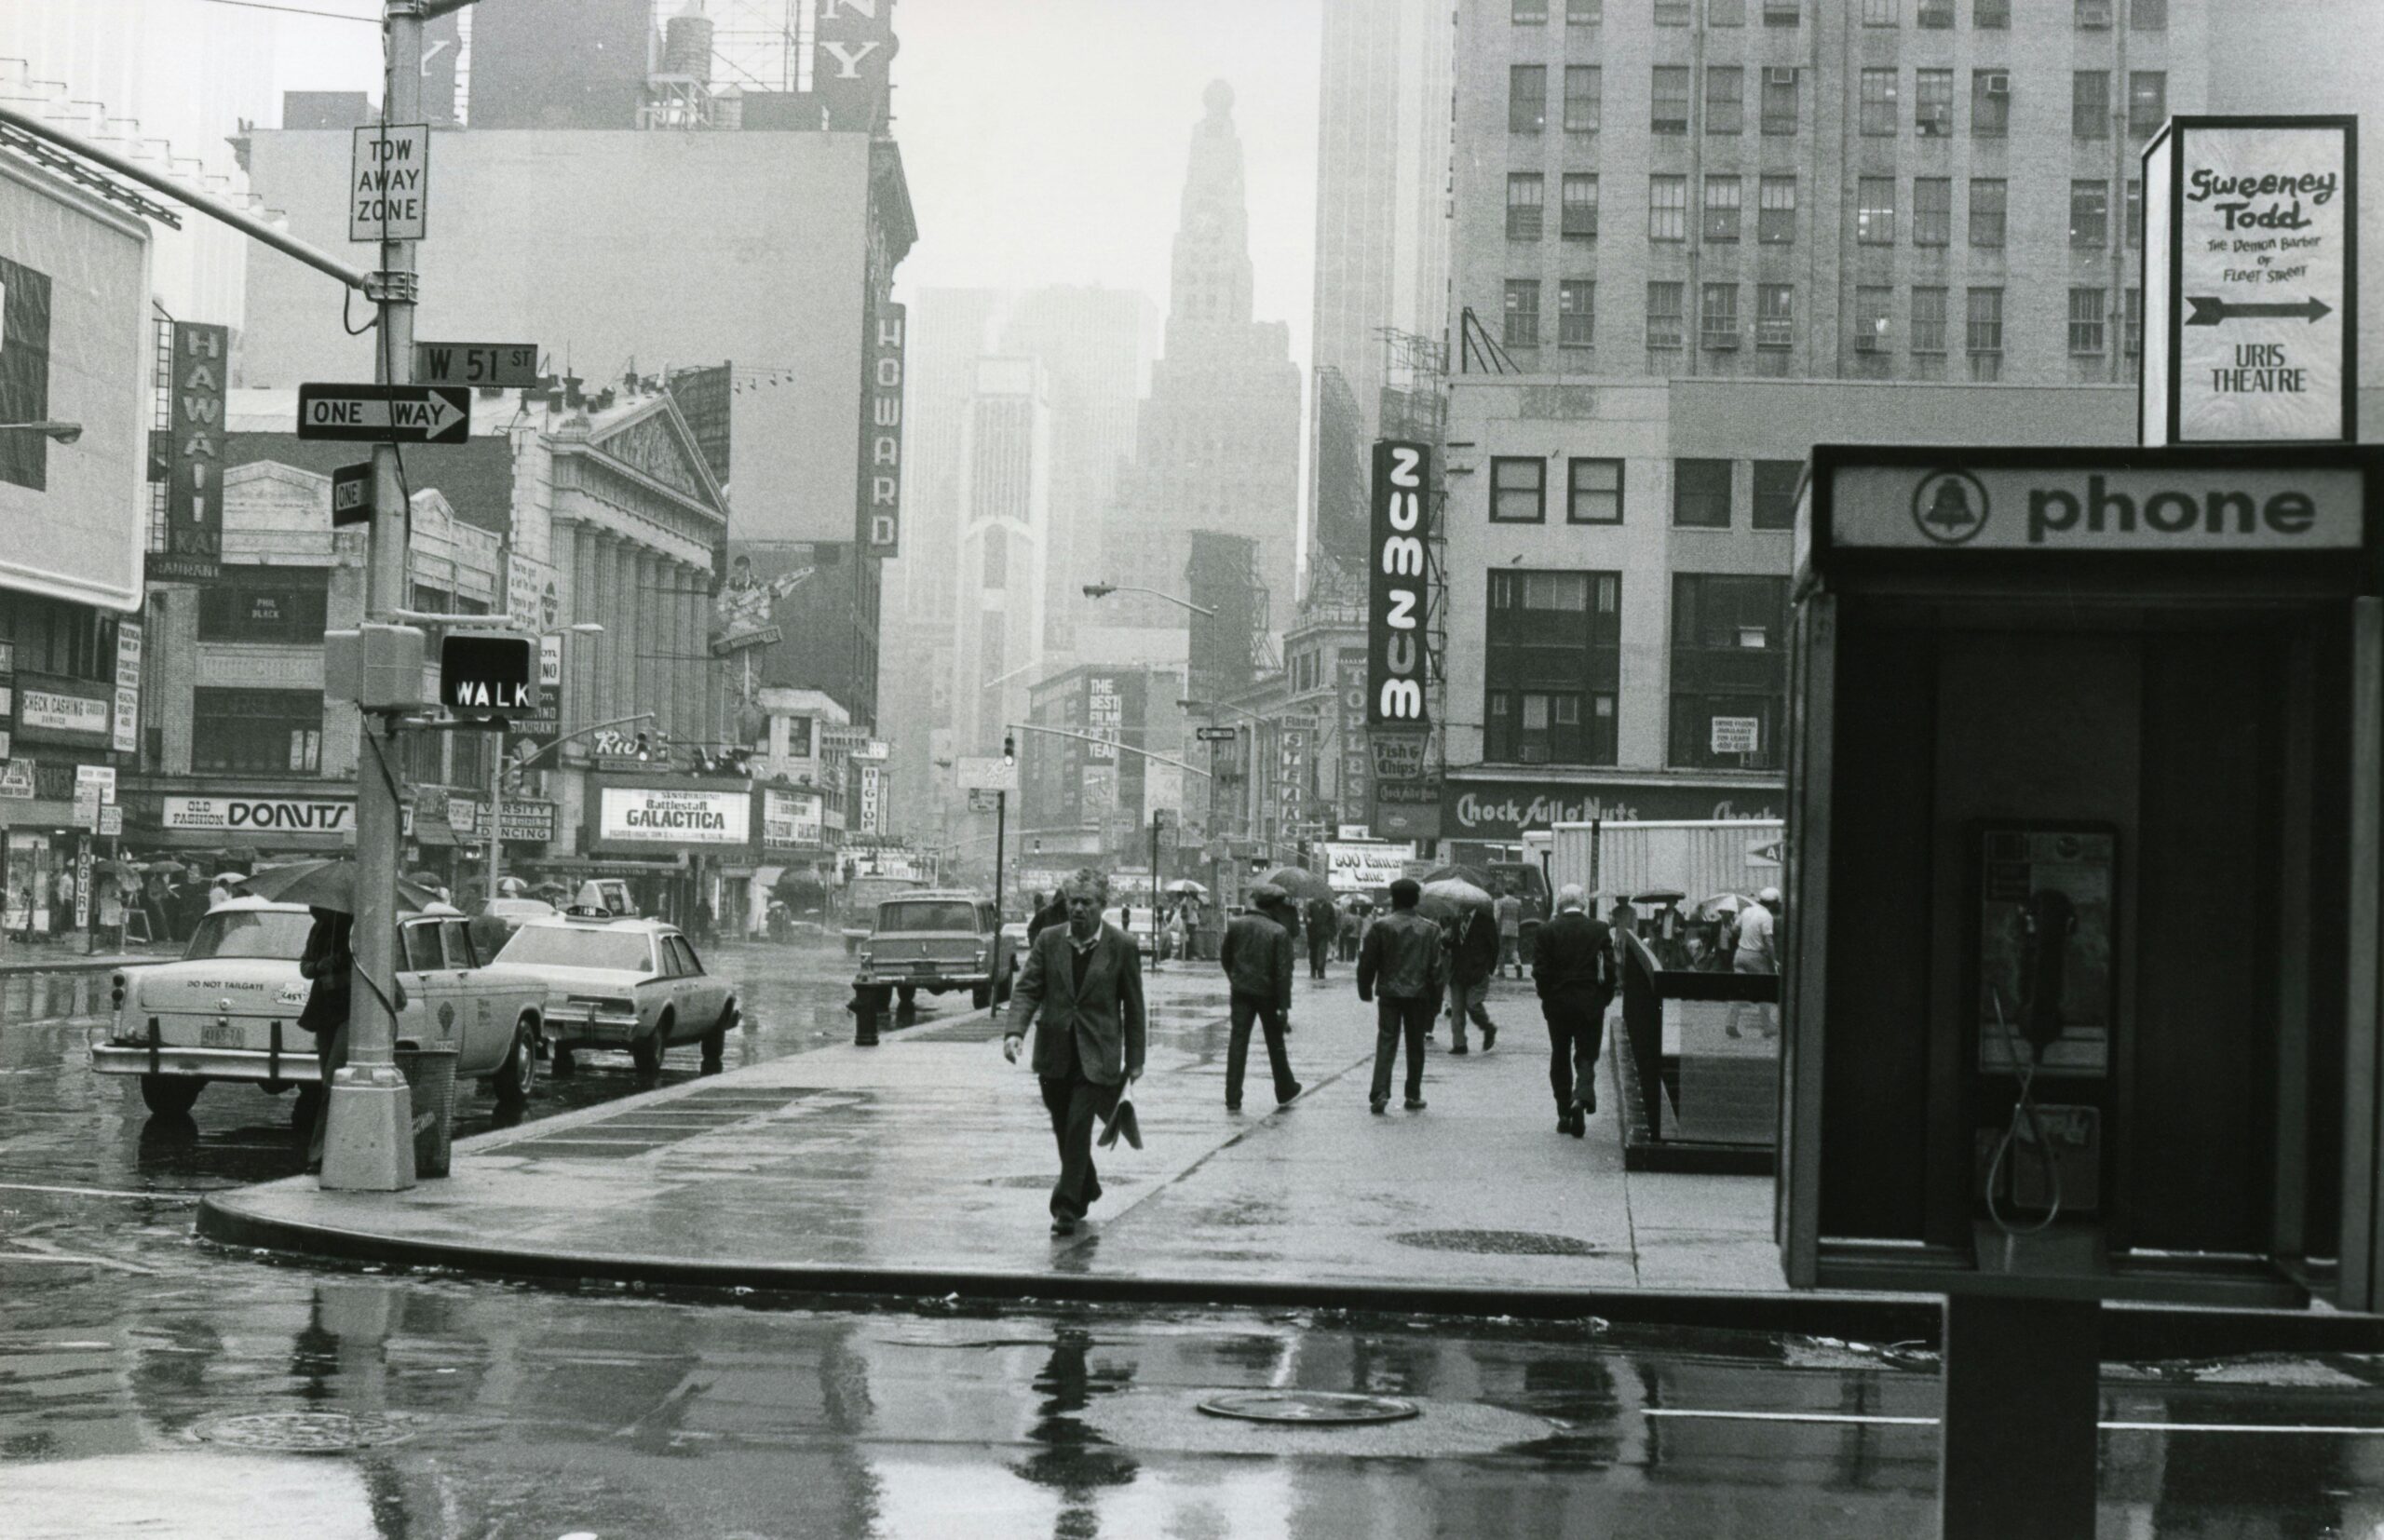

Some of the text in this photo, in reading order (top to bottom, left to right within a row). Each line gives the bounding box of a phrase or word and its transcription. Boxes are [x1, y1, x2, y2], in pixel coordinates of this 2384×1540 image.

[369, 139, 412, 162] TOW
[358, 168, 421, 193] AWAY
[2186, 168, 2339, 206] Sweeney
[357, 198, 418, 223] ZONE
[2214, 199, 2312, 232] Todd
[2233, 237, 2278, 253] Demon
[2280, 235, 2323, 251] Barber
[428, 348, 532, 382] W 51 ST
[2235, 343, 2286, 368] URIS
[2210, 368, 2308, 393] THEATRE
[313, 400, 446, 426] ONE WAY
[183, 330, 222, 523] HAWAII
[871, 318, 901, 546] HOWARD
[337, 482, 359, 508] ONE
[2027, 474, 2317, 544] phone
[455, 680, 530, 708] WALK
[1090, 679, 1114, 695] THE
[23, 694, 48, 712] CHECK
[51, 696, 84, 717] CASHING
[1089, 695, 1120, 709] BEST
[511, 721, 557, 736] STAURANT
[1346, 665, 1368, 819] TOPLESS
[1374, 742, 1408, 759] Fish
[1378, 759, 1417, 777] Chips
[173, 813, 224, 826] FASHION
[187, 801, 211, 813] OLD
[227, 802, 349, 829] DONUTS
[483, 803, 547, 815] VRSITY
[626, 809, 725, 830] GALACTICA
[1456, 793, 1521, 827] Chock
[1585, 796, 1638, 822] Nuts
[1713, 800, 1776, 820] Chock
[481, 827, 547, 839] DNCING
[77, 837, 90, 922] YOGURT
[186, 979, 265, 992] DO NOT TAILGATE
